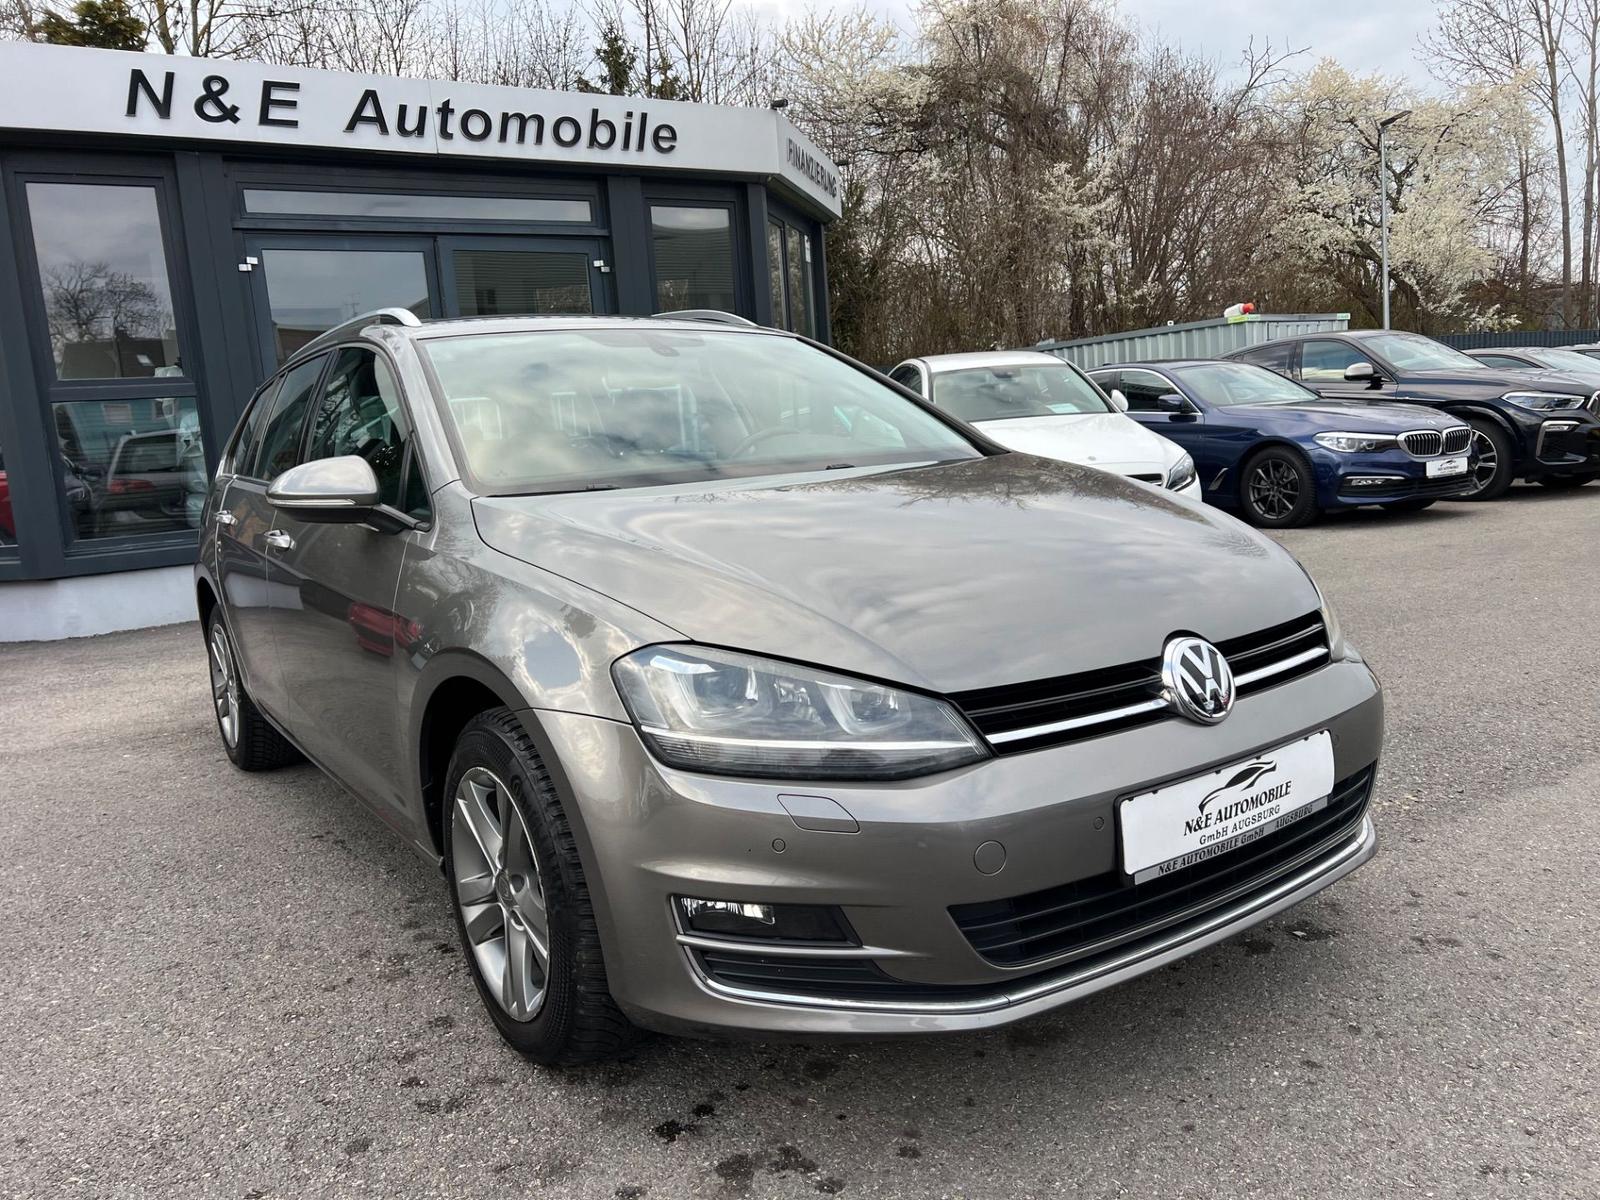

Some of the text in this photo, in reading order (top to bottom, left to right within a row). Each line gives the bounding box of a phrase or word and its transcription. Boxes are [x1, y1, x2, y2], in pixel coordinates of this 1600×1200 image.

[343, 89, 678, 154] Automobile
[786, 137, 838, 198] FINANZIERUNG
[1183, 780, 1292, 837] N&E AUTOMOBILE
[1199, 804, 1281, 846] GmbH AUGSBURG
[1158, 804, 1313, 876] N&E AUTOMOBILE GmbH AUGSBURG
